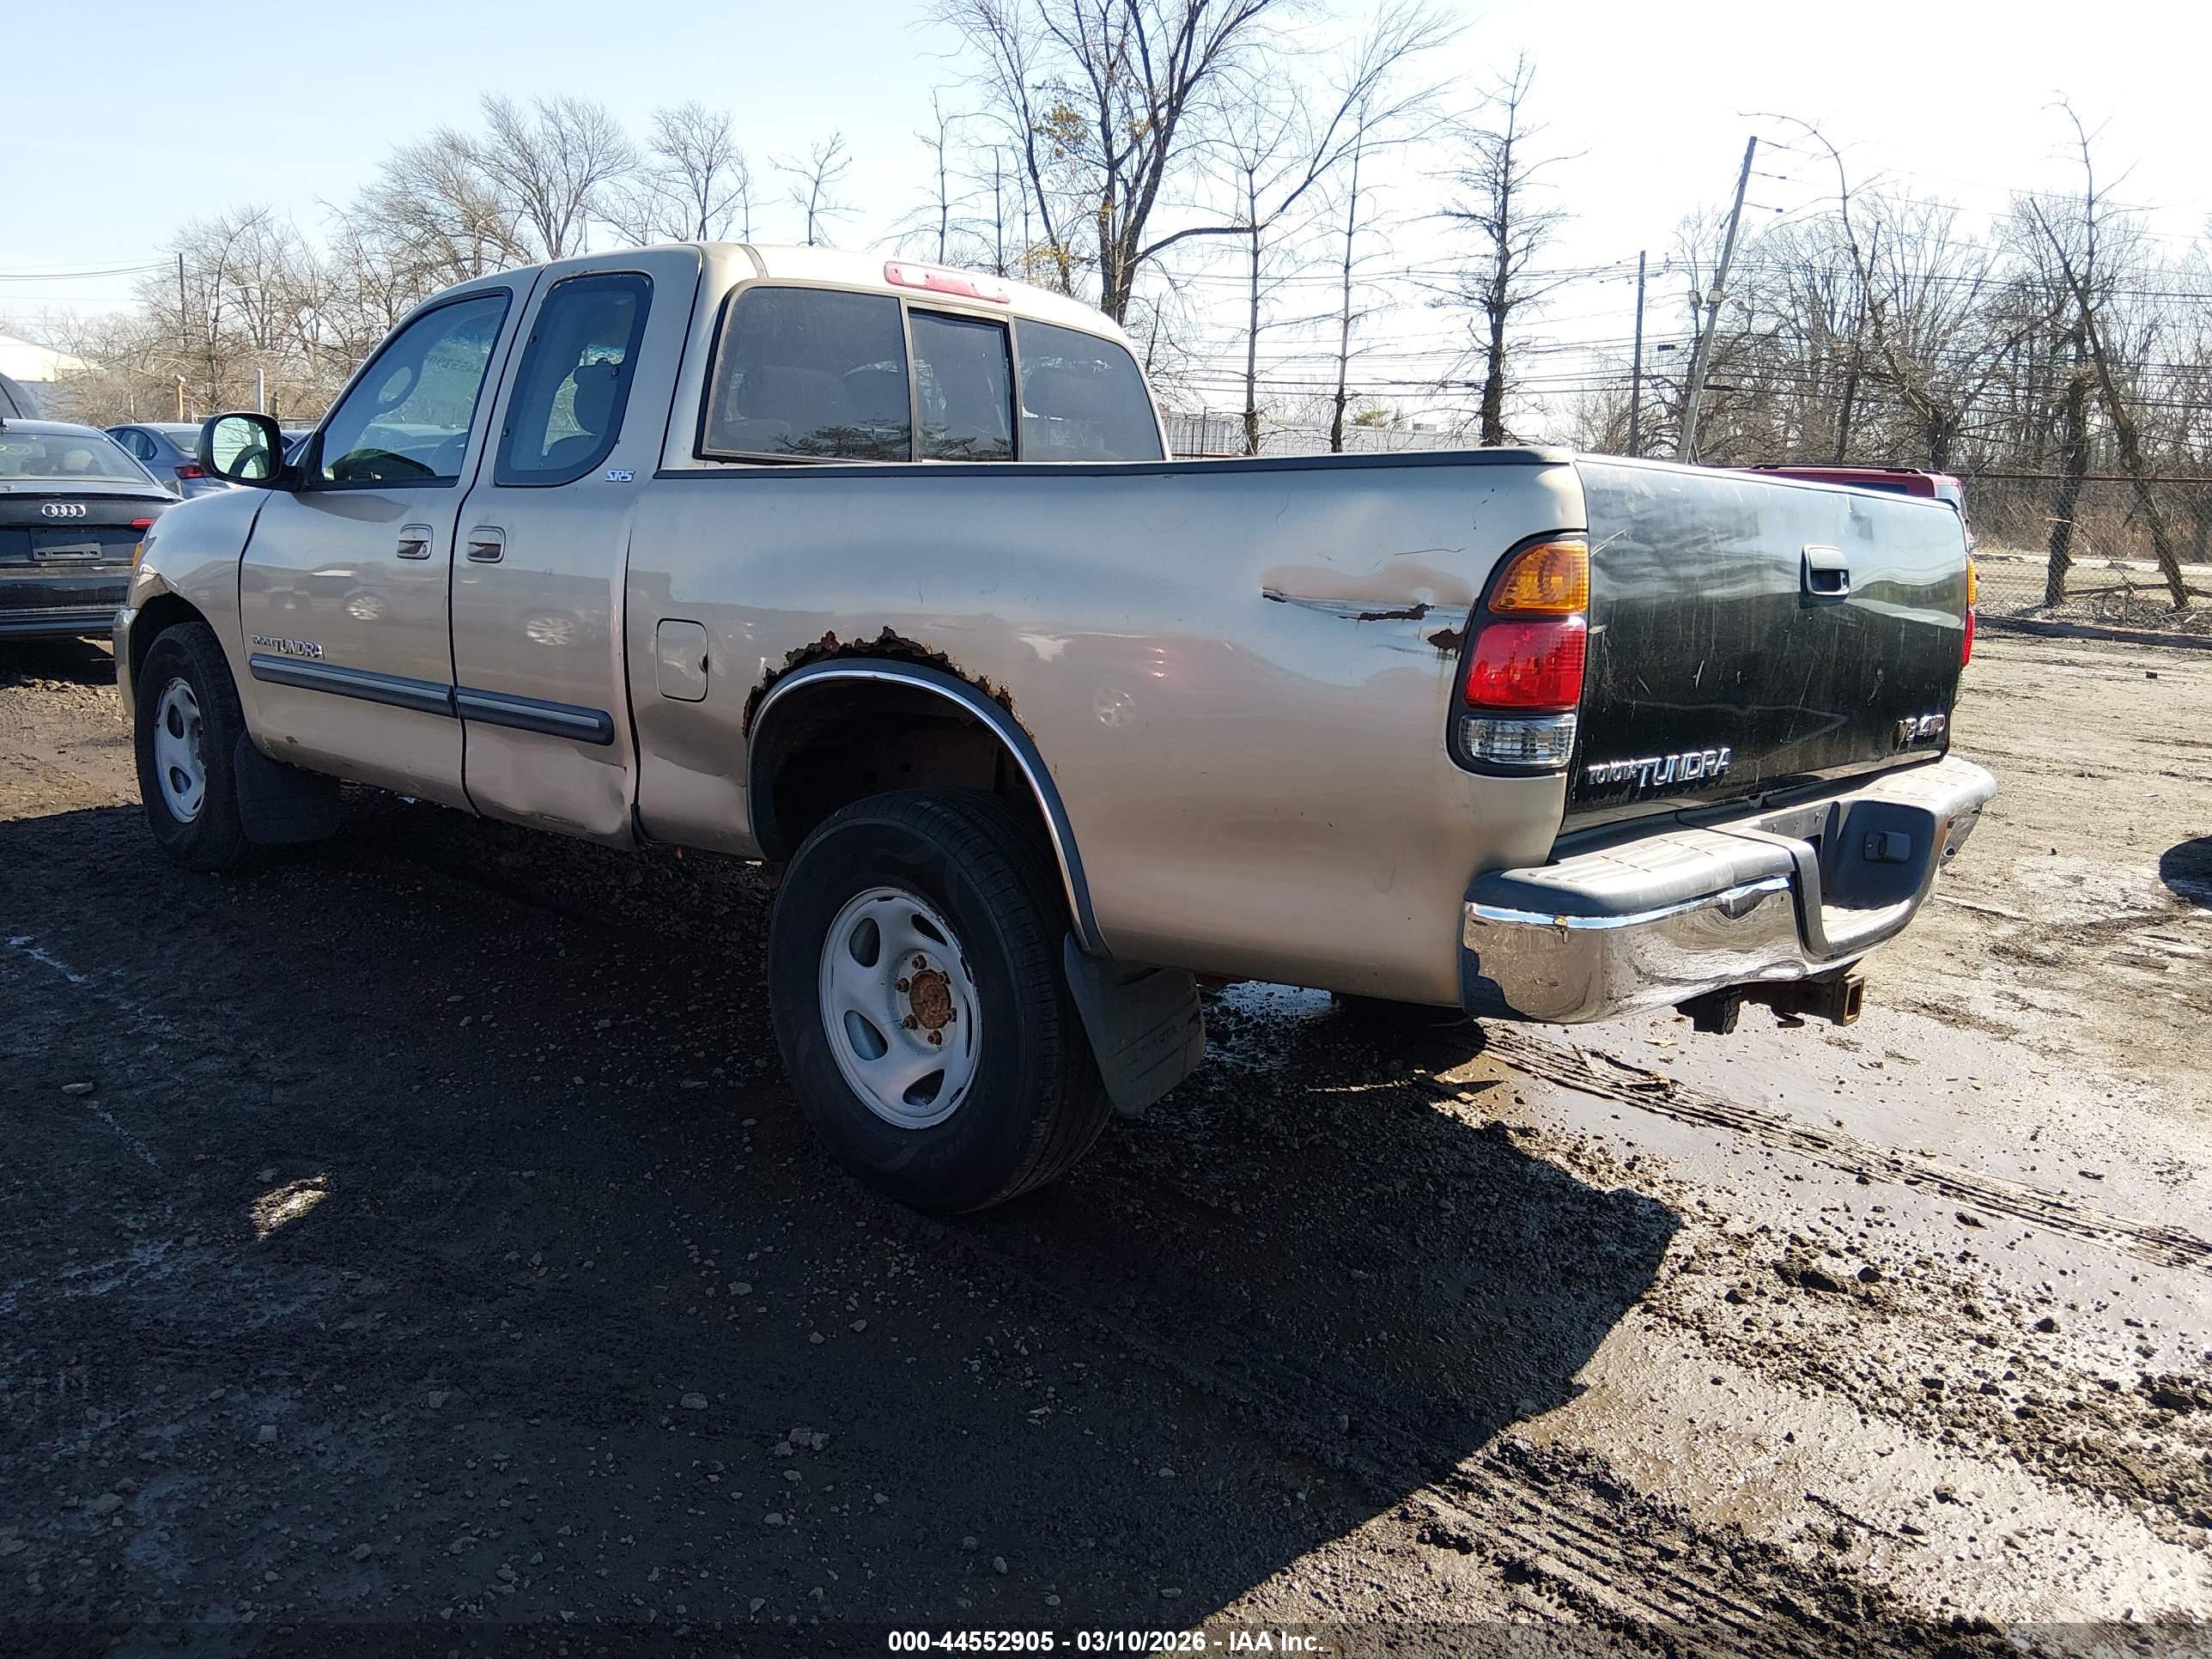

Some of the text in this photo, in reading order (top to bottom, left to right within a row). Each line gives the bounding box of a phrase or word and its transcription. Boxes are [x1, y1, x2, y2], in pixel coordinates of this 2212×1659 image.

[605, 470, 635, 482] SR5
[274, 638, 325, 659] TUNDRA
[1587, 747, 1732, 788] TOYOTA TUNDRA
